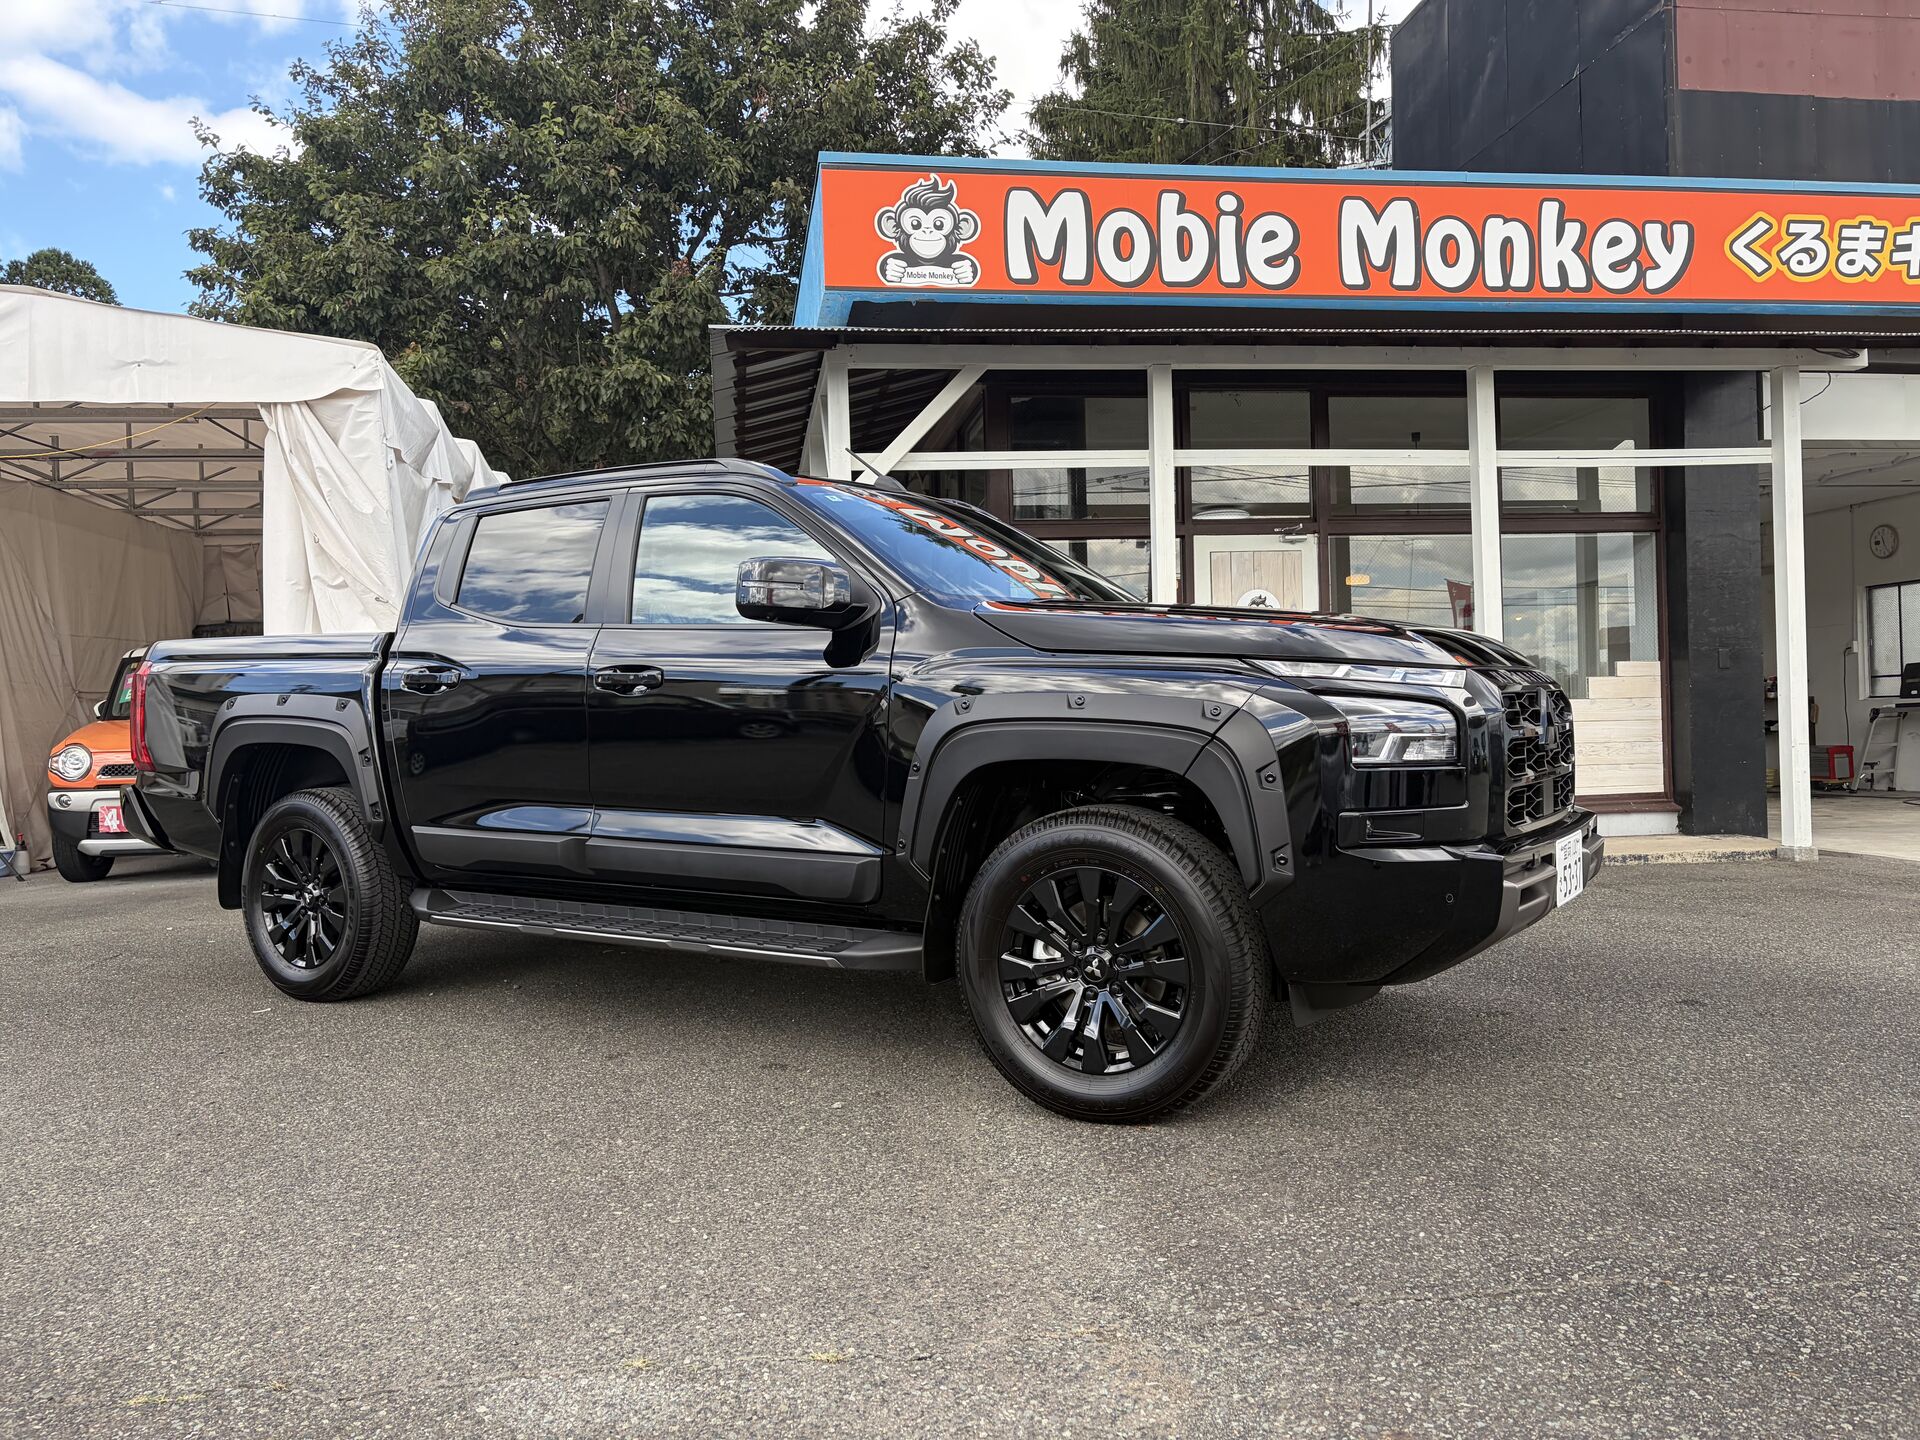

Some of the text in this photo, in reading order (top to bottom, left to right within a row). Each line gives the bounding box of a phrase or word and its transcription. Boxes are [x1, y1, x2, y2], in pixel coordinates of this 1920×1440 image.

[1004, 187, 1694, 294] Mobie Monkey
[906, 271, 955, 281] Mobie Monkey
